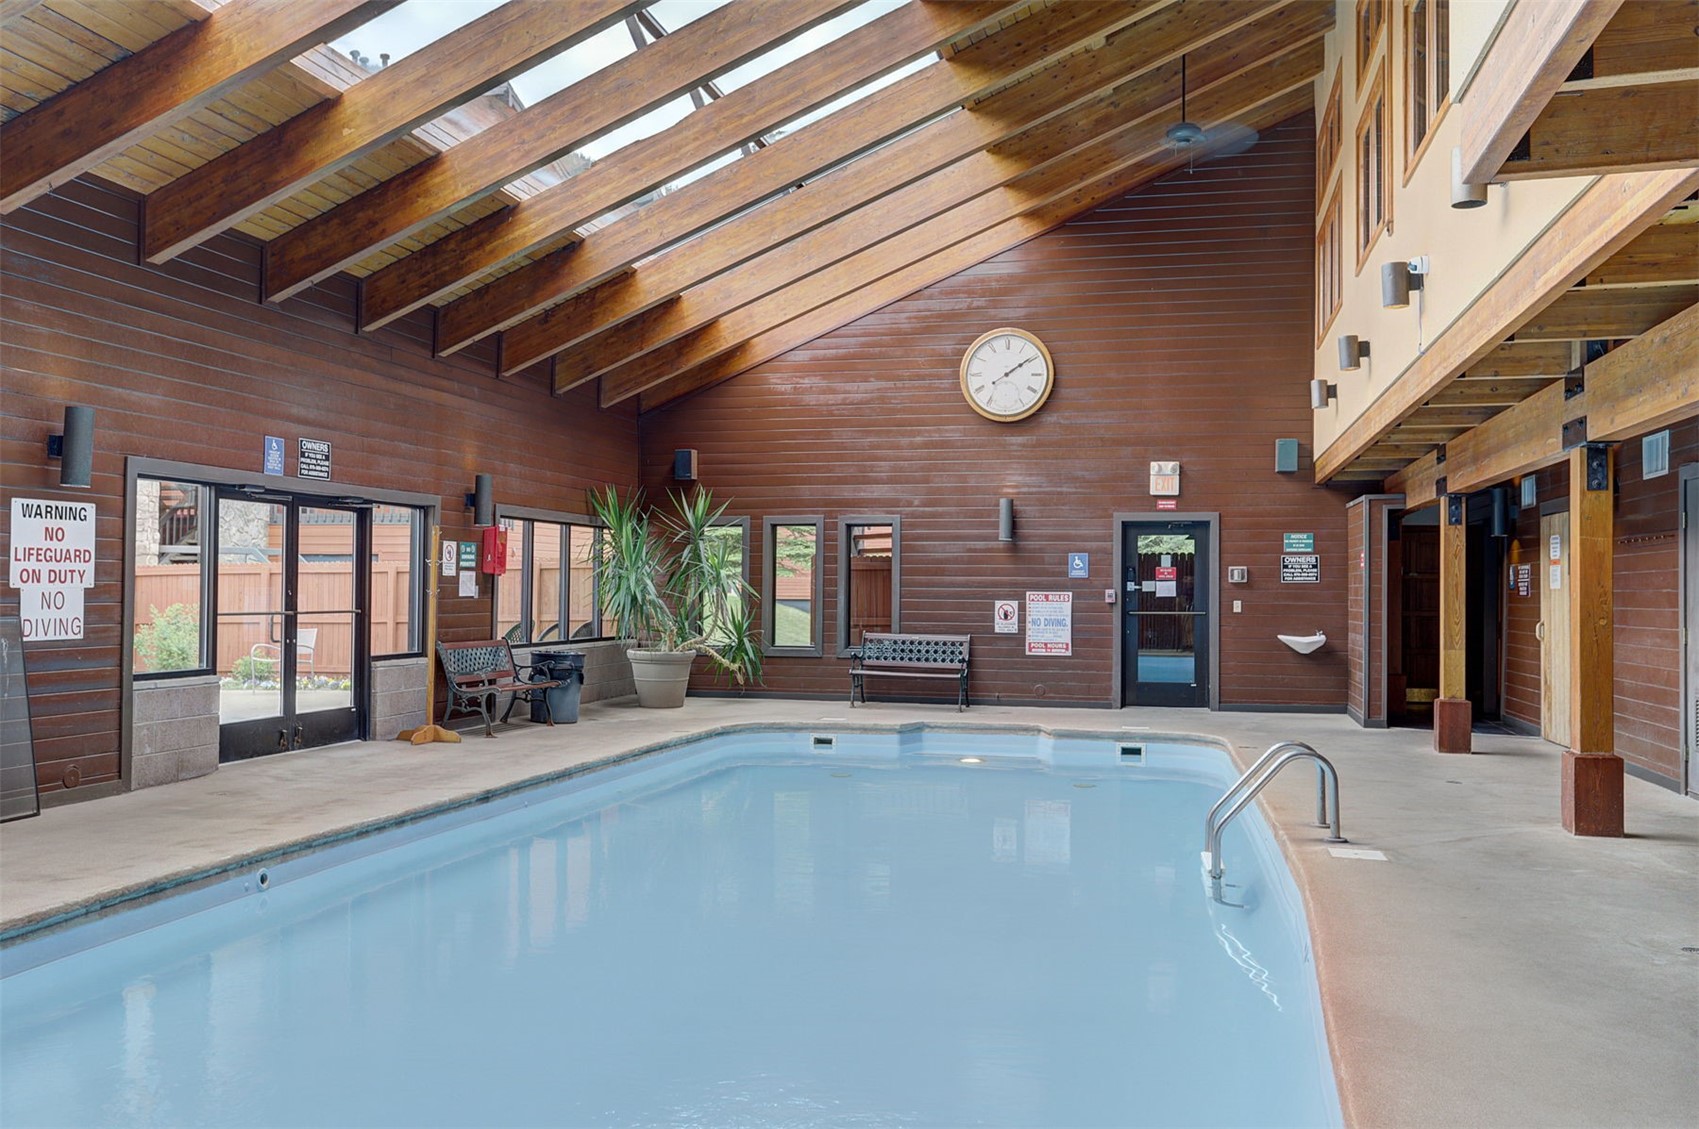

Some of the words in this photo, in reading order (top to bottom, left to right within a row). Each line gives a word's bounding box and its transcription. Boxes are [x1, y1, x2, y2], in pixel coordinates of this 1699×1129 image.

[302, 441, 328, 452] OWNERS
[1155, 478, 1174, 491] EXIT
[21, 503, 88, 522] WARNING
[44, 527, 65, 542] NO
[14, 547, 92, 564] LIFEGUARD
[20, 568, 41, 584] ON
[48, 569, 86, 584] DUTY
[41, 591, 65, 610] NO
[22, 617, 82, 638] DIVING
[1032, 618, 1041, 627] NO
